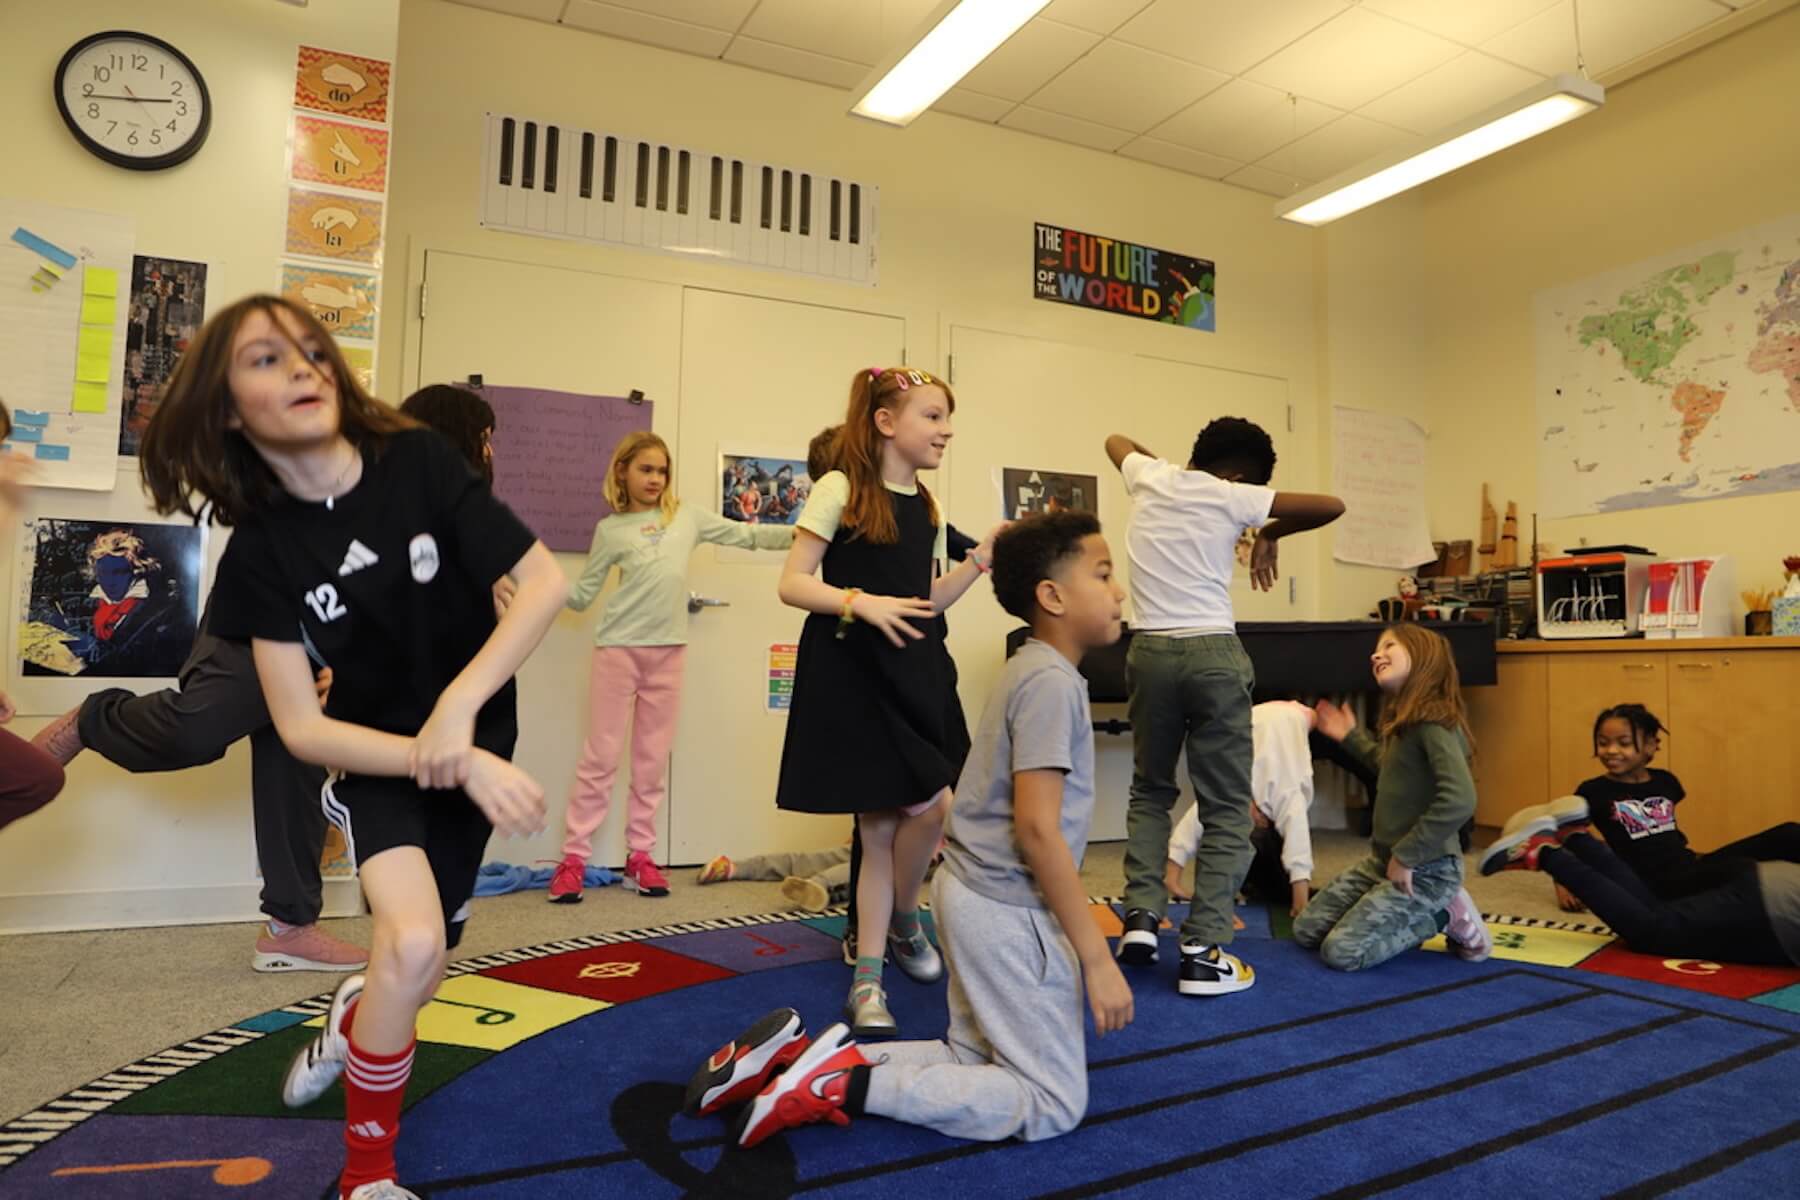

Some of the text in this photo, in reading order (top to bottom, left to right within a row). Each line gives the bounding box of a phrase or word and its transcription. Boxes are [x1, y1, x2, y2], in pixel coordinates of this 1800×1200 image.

[110, 54, 123, 71] 11
[131, 54, 148, 71] 12
[93, 65, 111, 83] 10
[159, 64, 165, 80] 1
[82, 83, 95, 98] 9
[170, 81, 183, 96] 2
[328, 87, 351, 102] do
[87, 103, 100, 119] 8
[175, 101, 187, 116] 3
[106, 120, 118, 135] 7
[166, 119, 177, 132] 4
[127, 130, 139, 145] 6
[150, 129, 161, 144] 5
[1036, 225, 1160, 287] THE FUTURE
[1037, 269, 1056, 282] OF
[1037, 282, 1057, 295] THE
[1058, 272, 1161, 316] WORLD
[304, 582, 348, 623] 12
